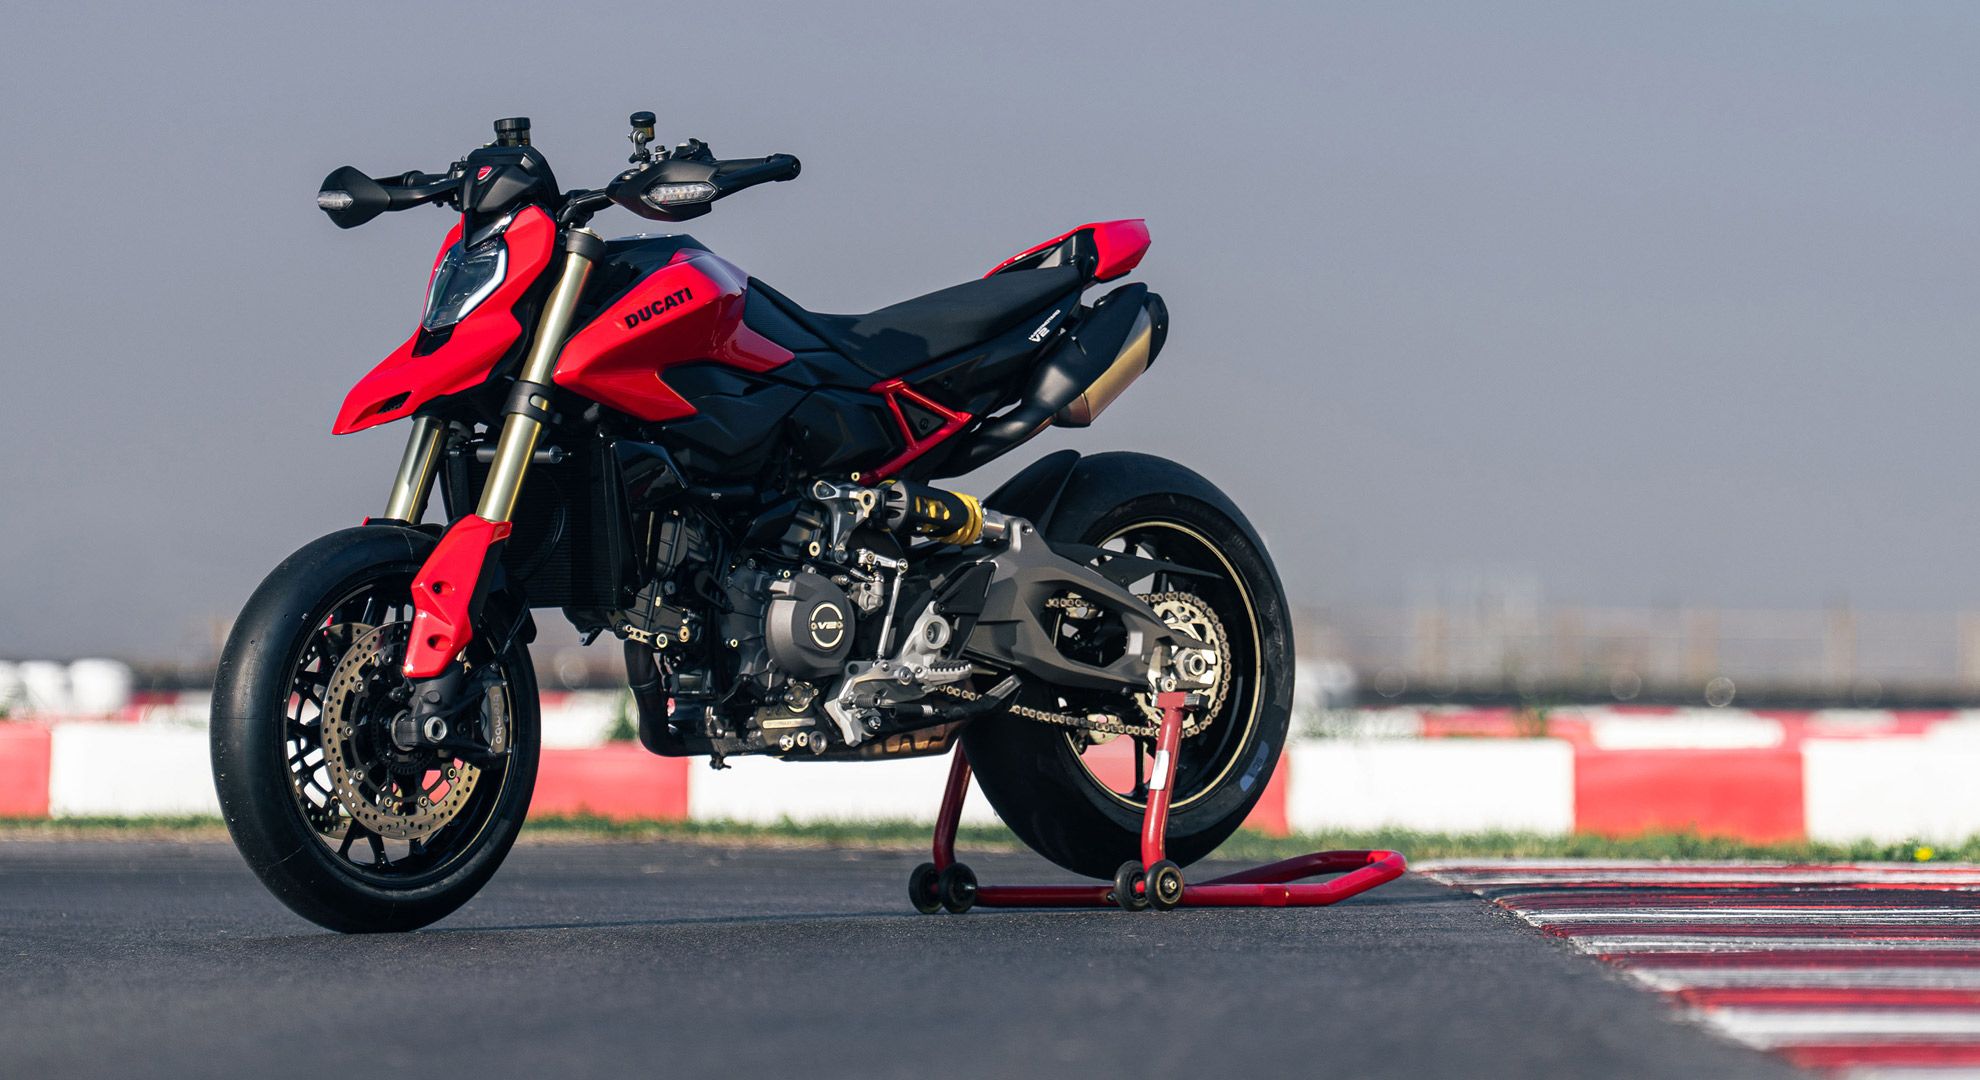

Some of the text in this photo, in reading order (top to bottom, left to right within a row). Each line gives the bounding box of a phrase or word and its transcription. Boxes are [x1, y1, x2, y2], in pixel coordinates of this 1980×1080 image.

[624, 287, 693, 329] DUCATI
[1028, 327, 1050, 342] V2
[817, 621, 837, 630] V2
[493, 694, 503, 745] brembo
